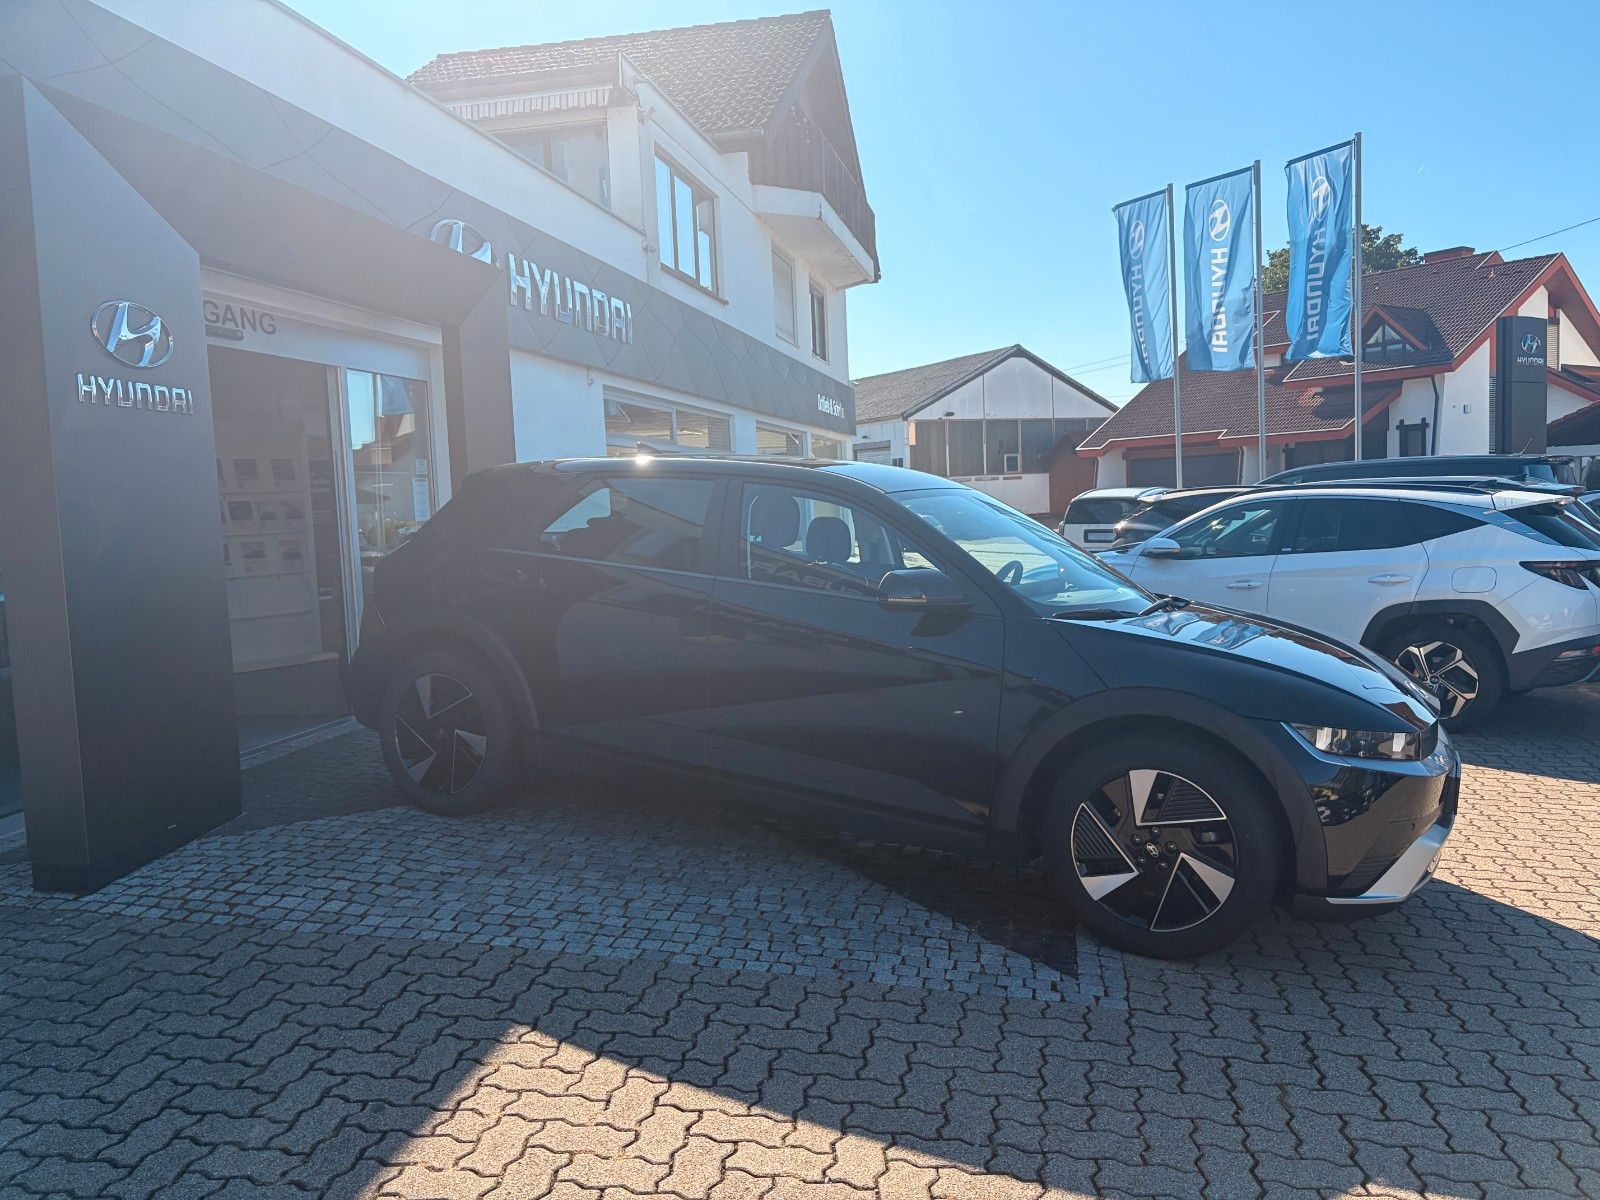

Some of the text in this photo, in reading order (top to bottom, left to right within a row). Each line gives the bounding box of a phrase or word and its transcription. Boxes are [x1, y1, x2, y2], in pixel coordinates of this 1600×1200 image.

[203, 299, 277, 335] GANG
[508, 252, 634, 345] HYUNDAI
[1517, 356, 1544, 366] HYUNDAI
[77, 373, 193, 415] HYUNDAI
